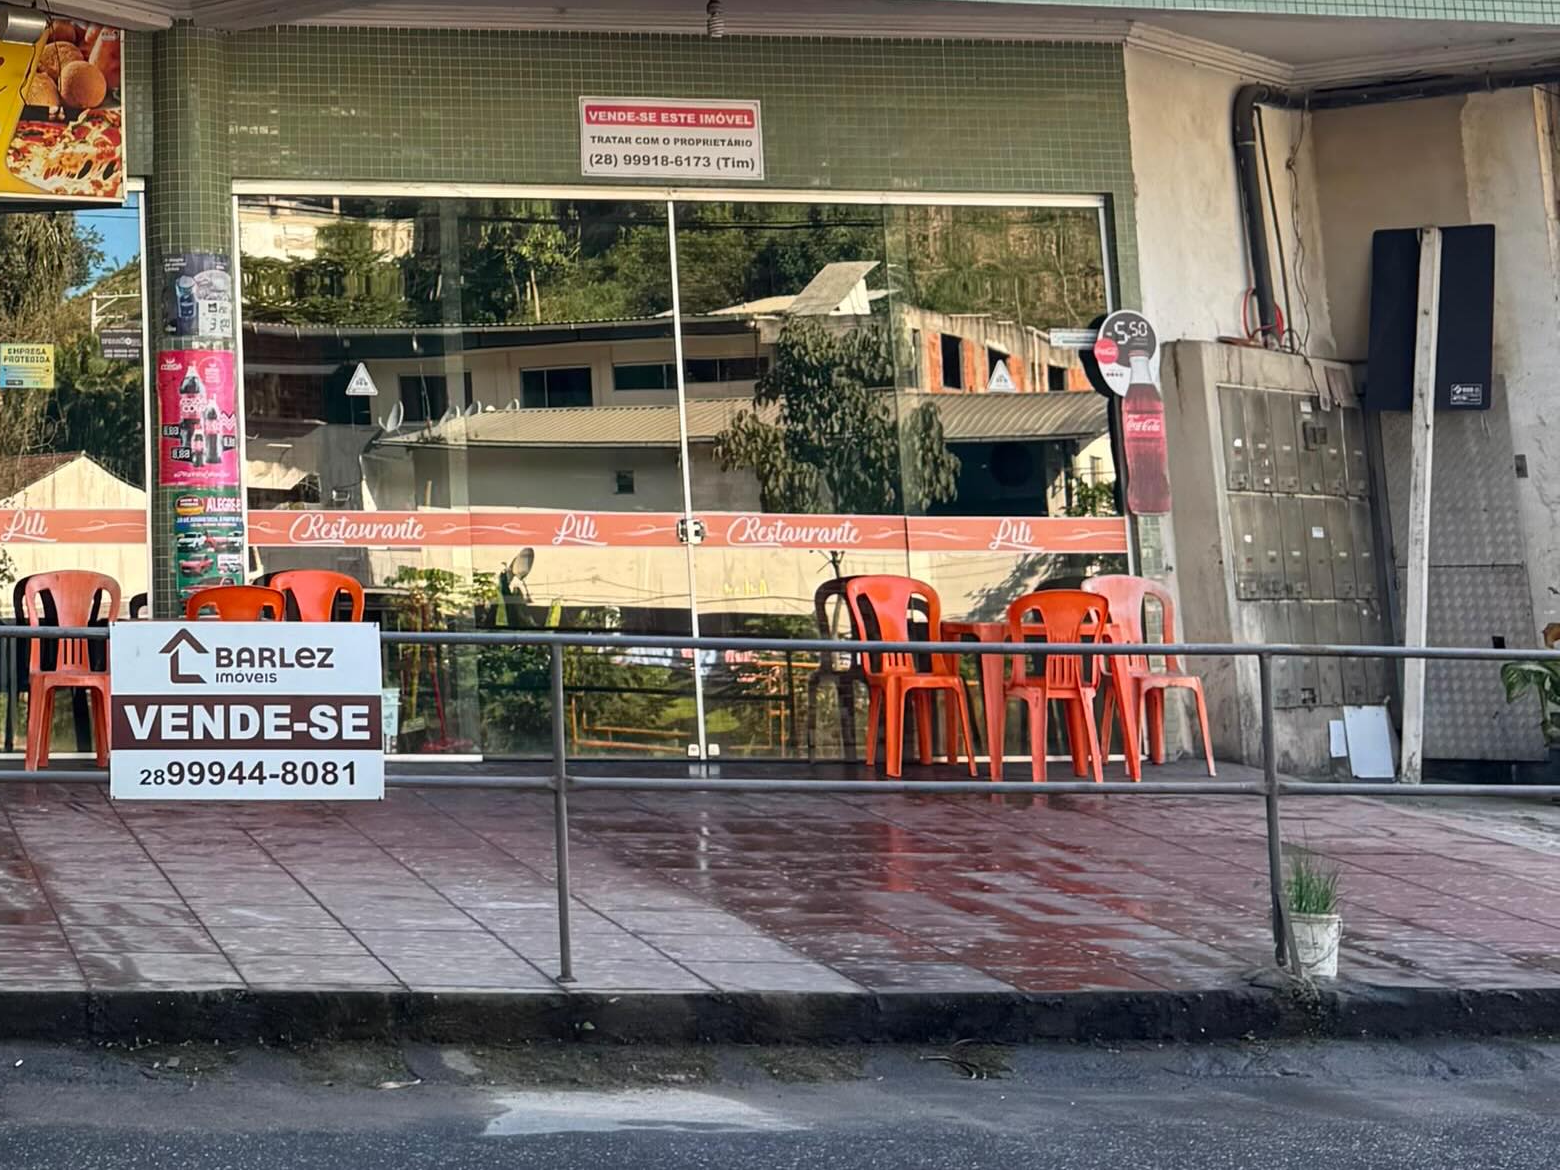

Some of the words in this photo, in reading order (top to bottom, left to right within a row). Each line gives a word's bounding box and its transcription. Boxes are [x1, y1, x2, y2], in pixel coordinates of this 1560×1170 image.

[589, 111, 658, 124] VENDE-SE
[660, 113, 696, 125] ESTE
[699, 112, 752, 126] IMÓVEL
[590, 135, 632, 146] TRATAR
[635, 137, 659, 146] COM
[662, 137, 671, 146] O
[673, 136, 753, 148] PROPRIETÁRIO
[589, 153, 618, 168] (28)
[622, 154, 712, 168] 99918-6173
[716, 157, 755, 171] (Tim)
[0, 509, 58, 543] Lili
[289, 513, 426, 547] Restaurante
[552, 513, 609, 548] Lili
[726, 516, 862, 549] Restaurante
[988, 518, 1045, 552] Lili
[123, 704, 371, 741] VENDE-SE
